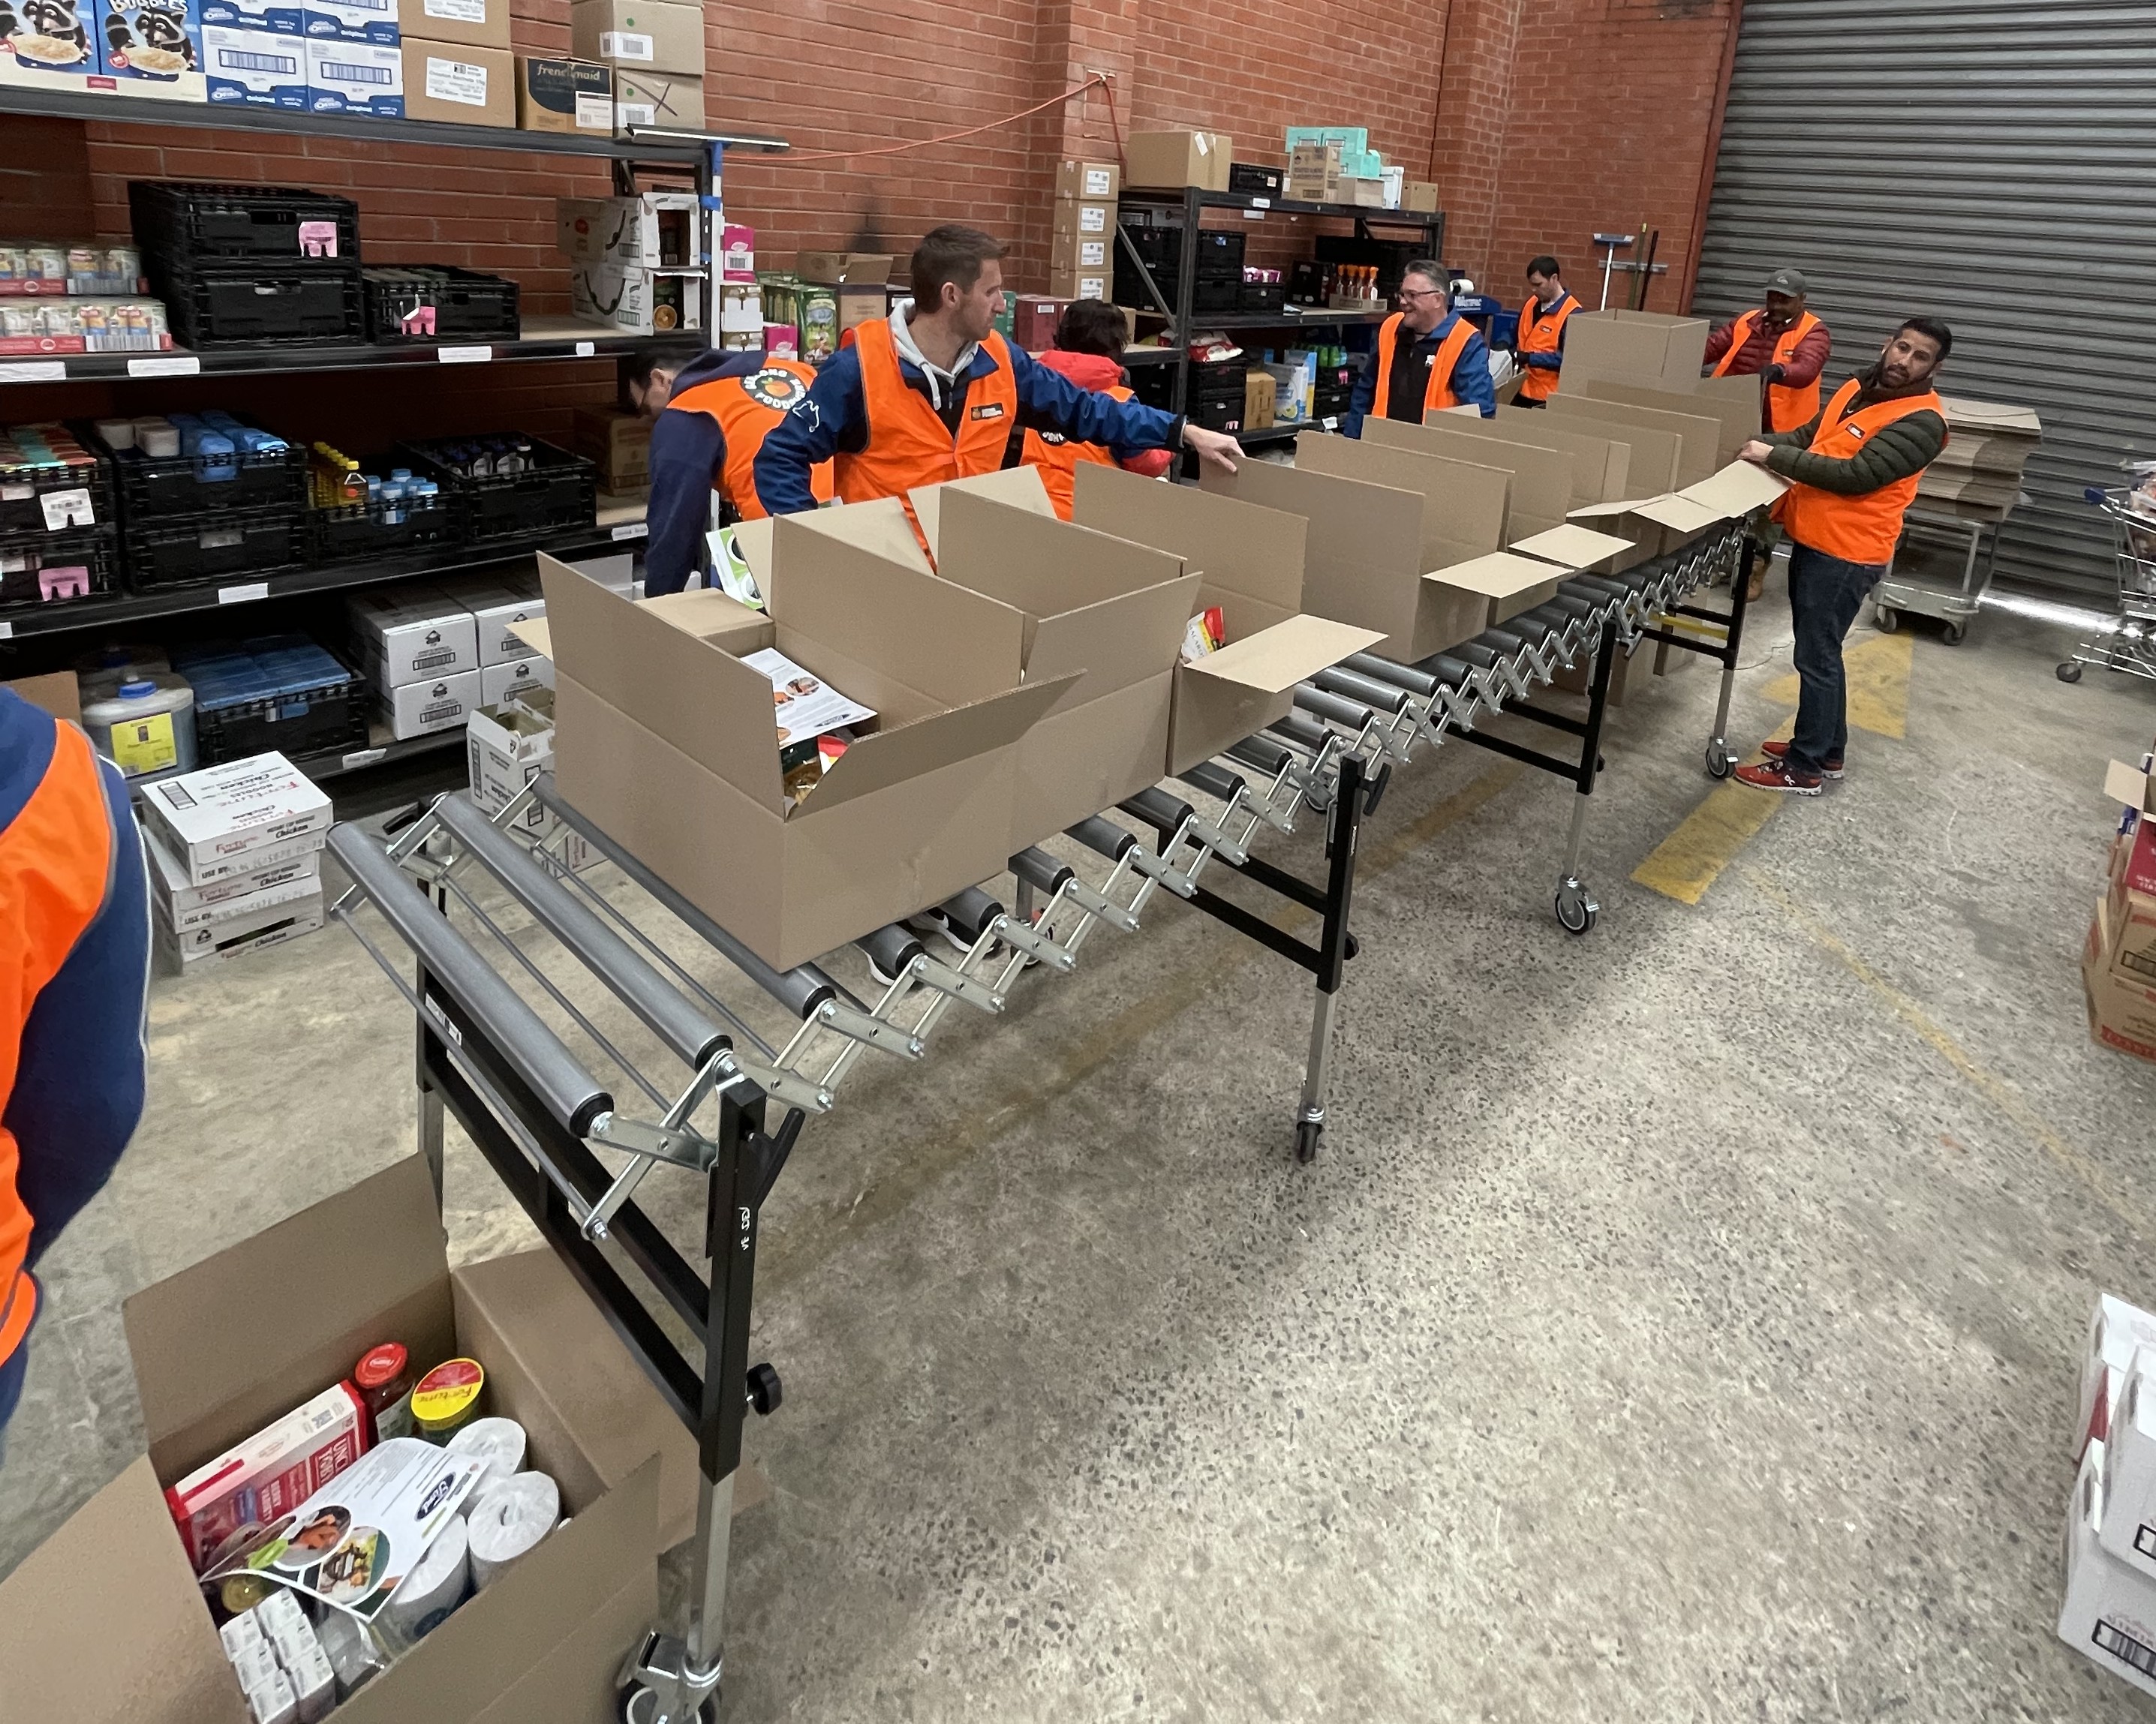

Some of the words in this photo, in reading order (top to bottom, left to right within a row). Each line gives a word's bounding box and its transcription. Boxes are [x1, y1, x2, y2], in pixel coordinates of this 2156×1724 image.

[275, 824, 308, 838] Chicken
[260, 873, 294, 887] Chicken
[255, 932, 287, 948] Chicken
